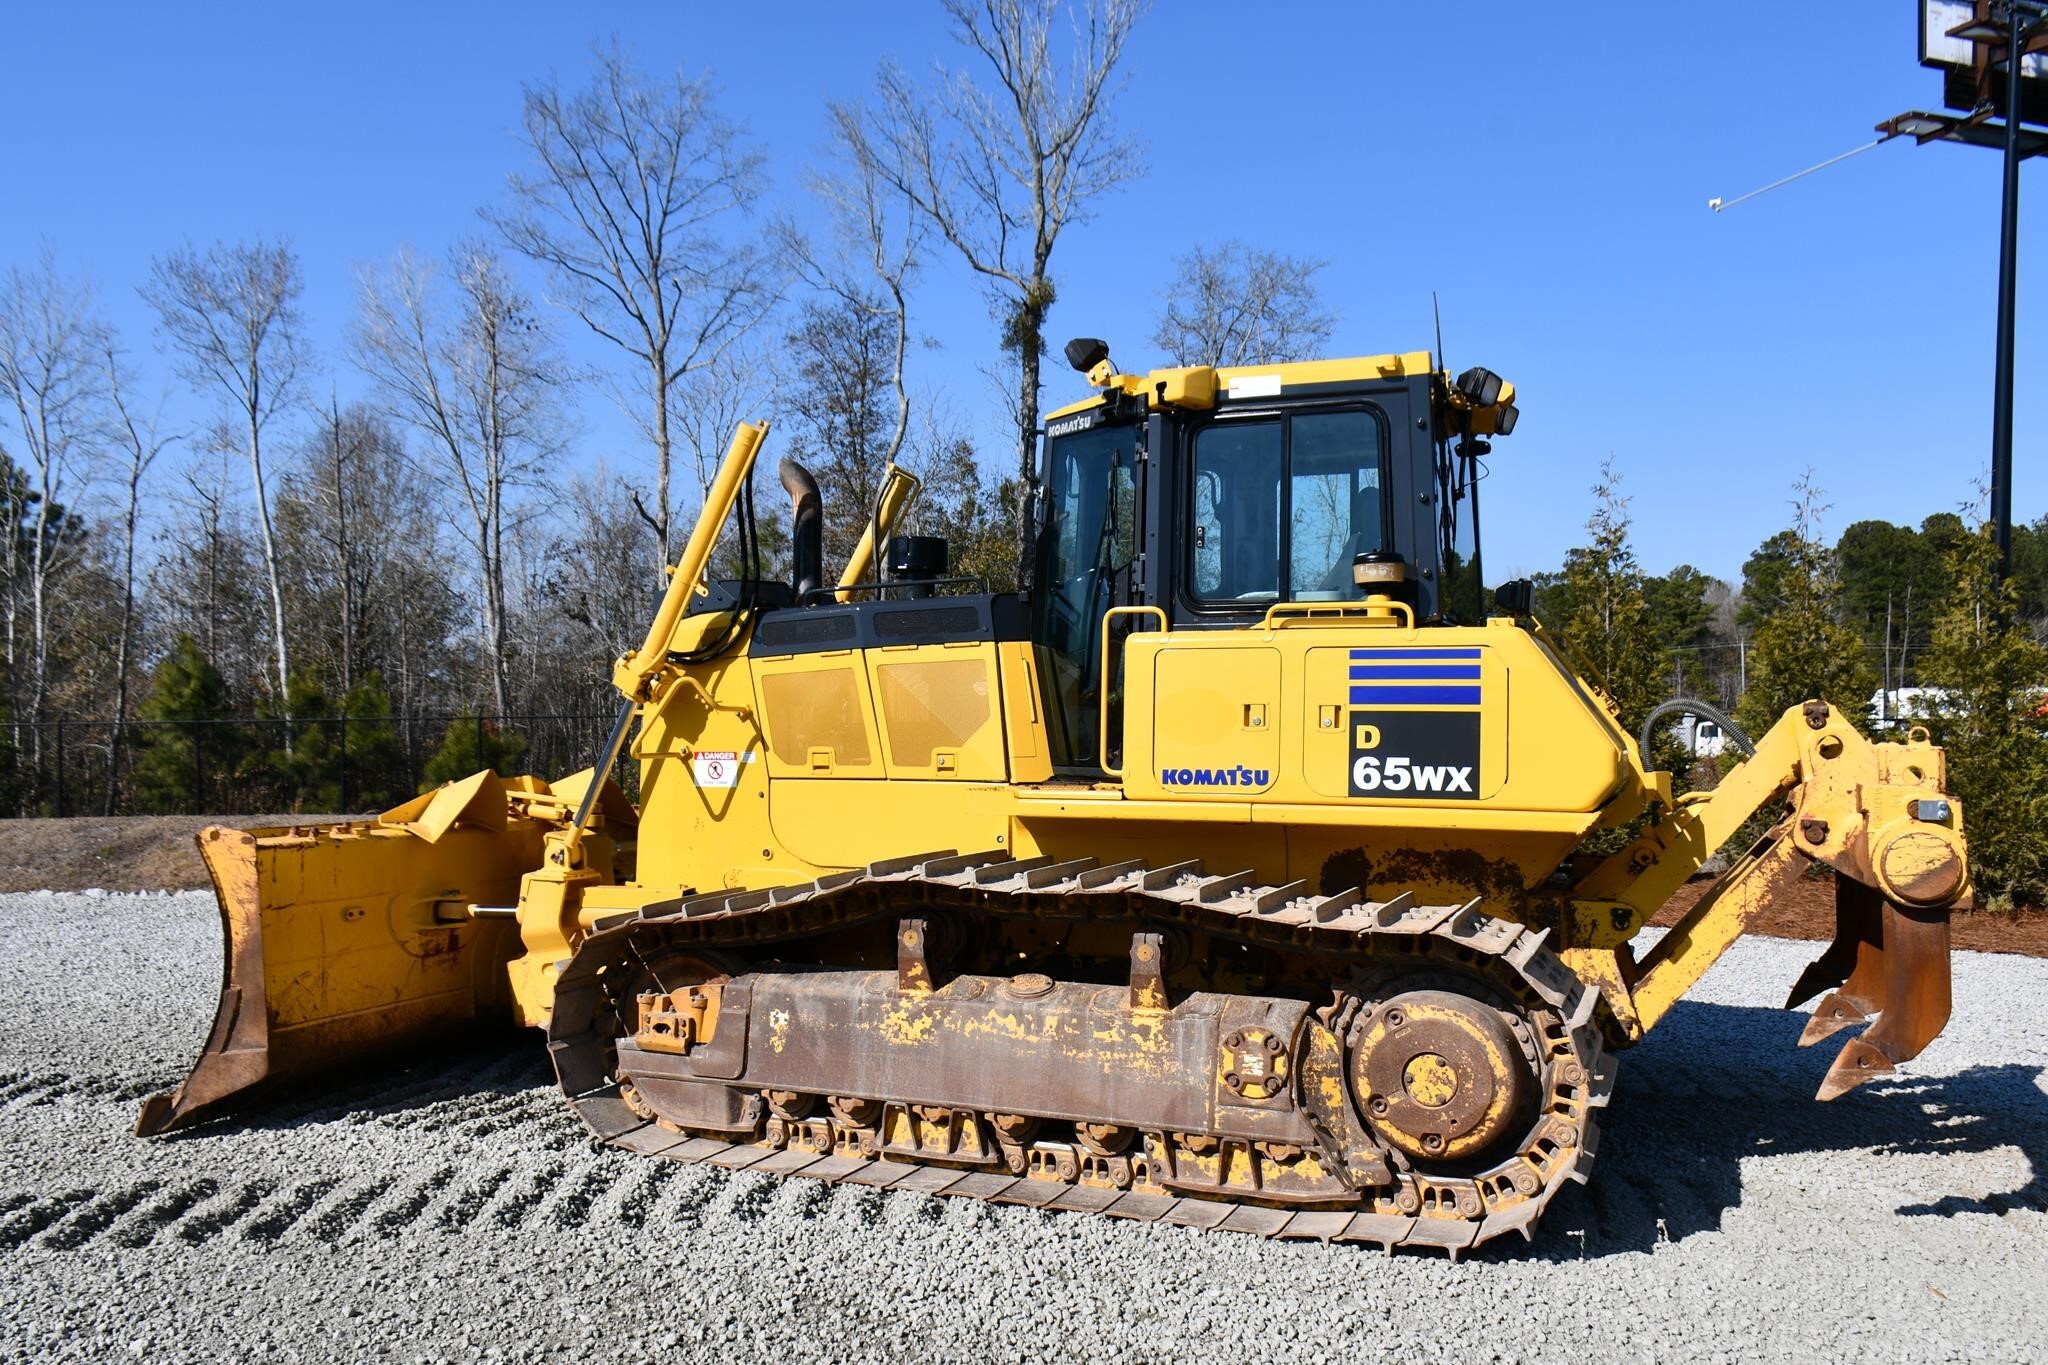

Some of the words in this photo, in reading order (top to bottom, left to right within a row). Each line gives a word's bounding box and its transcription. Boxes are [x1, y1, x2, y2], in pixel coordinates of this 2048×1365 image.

[1048, 416, 1091, 437] KOMATSU
[1356, 725, 1381, 749] D
[704, 752, 735, 760] DANGER
[1162, 765, 1269, 786] KOMATSU
